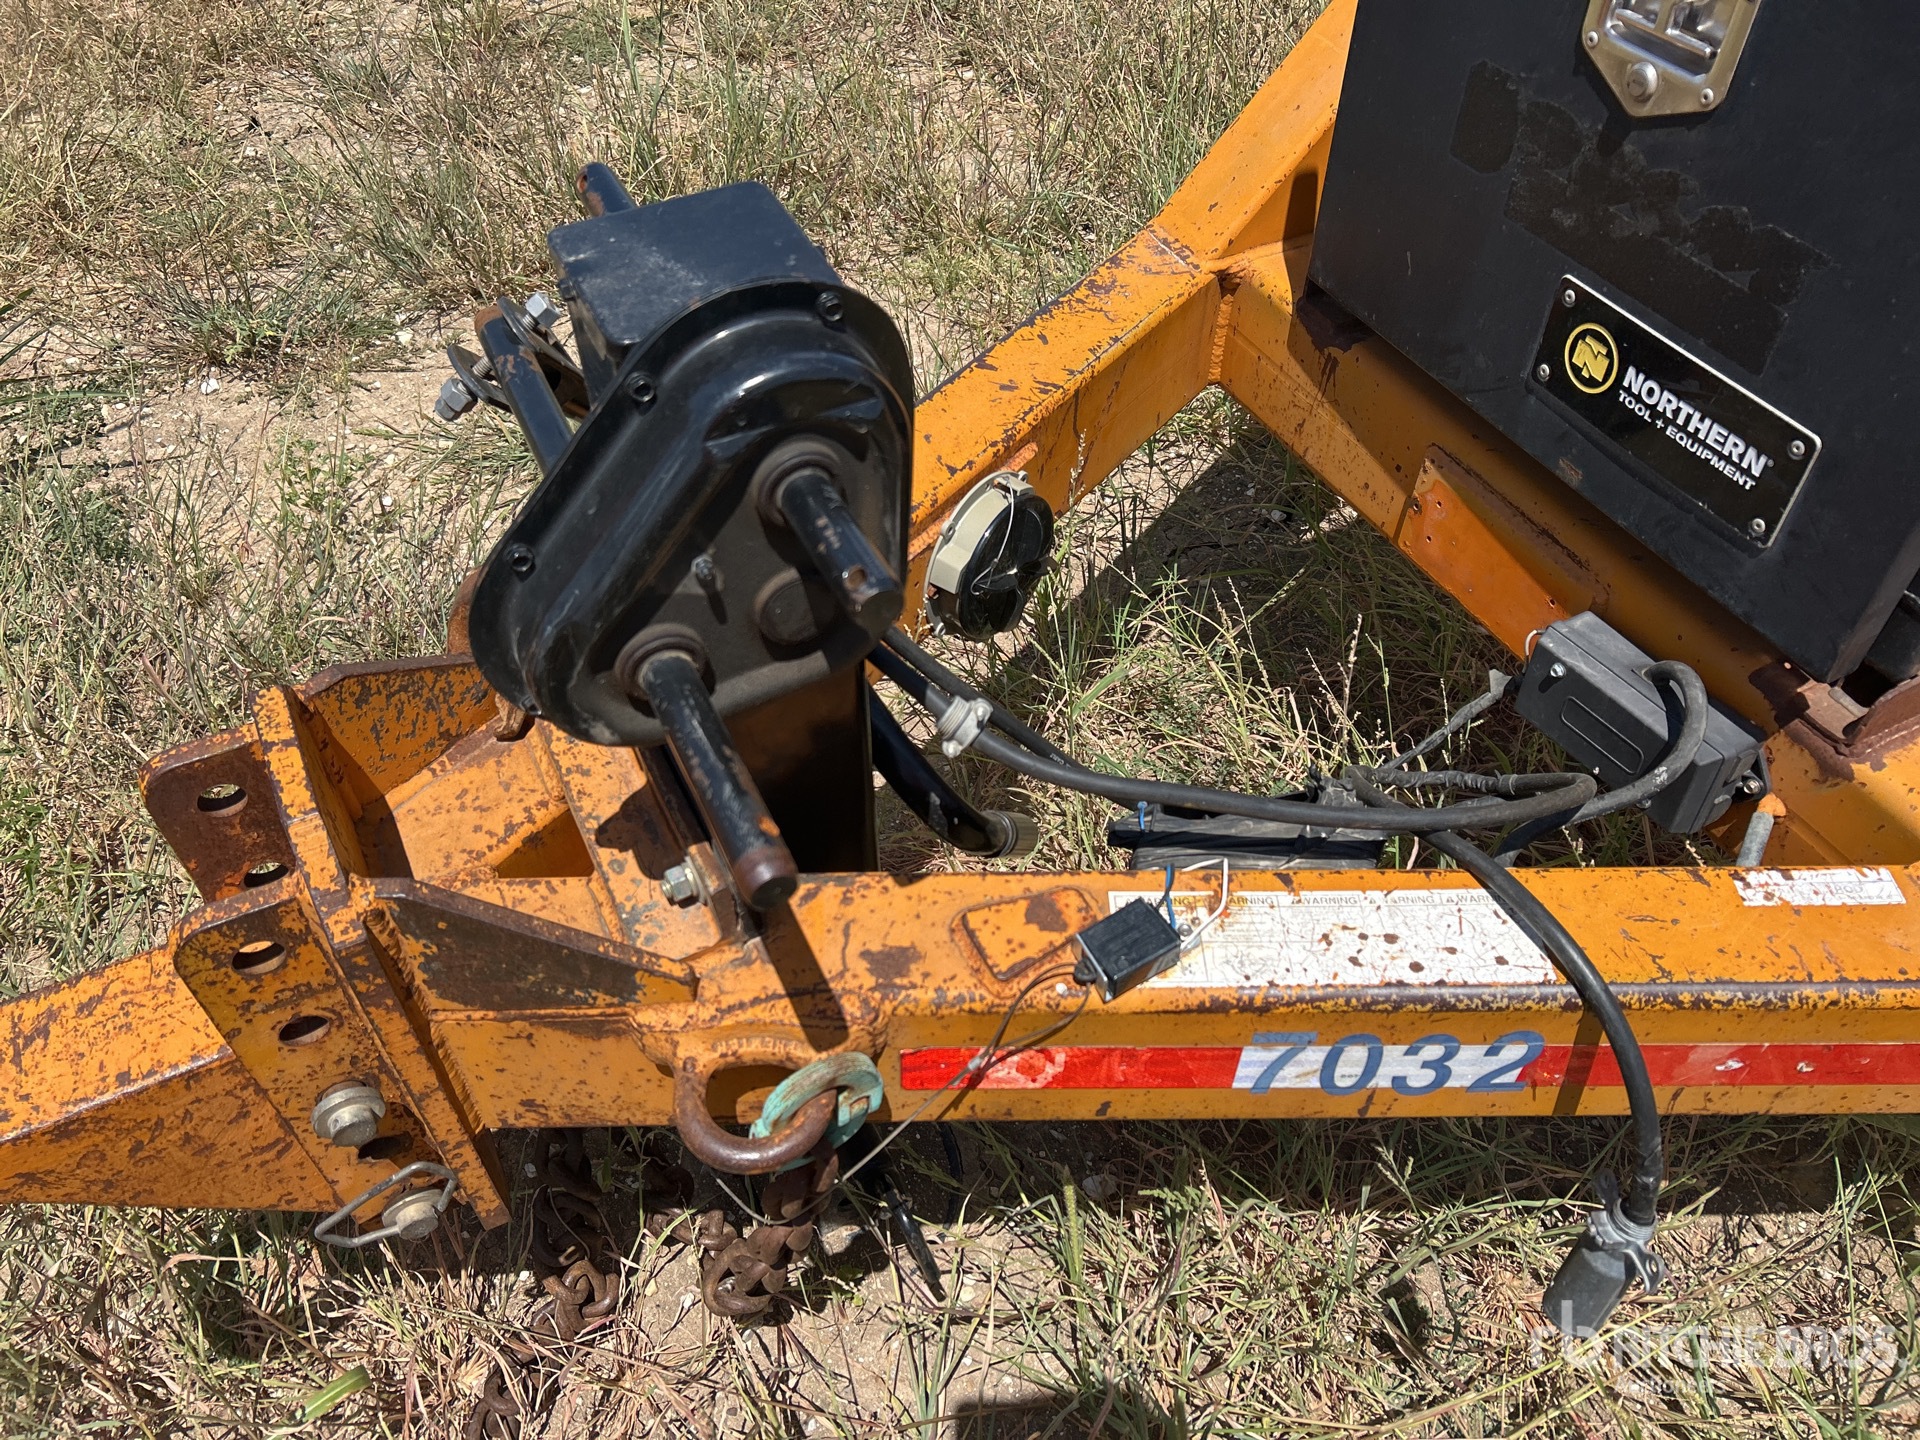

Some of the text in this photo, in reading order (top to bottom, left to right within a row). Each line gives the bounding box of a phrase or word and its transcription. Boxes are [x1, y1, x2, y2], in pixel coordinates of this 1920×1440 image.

[1618, 388, 1653, 424] TOOL
[1665, 424, 1757, 491] EQUIPMENT
[1622, 364, 1768, 478] NORTHERN
[1228, 896, 1275, 905] ARNING
[1249, 1030, 1546, 1096] 7032
